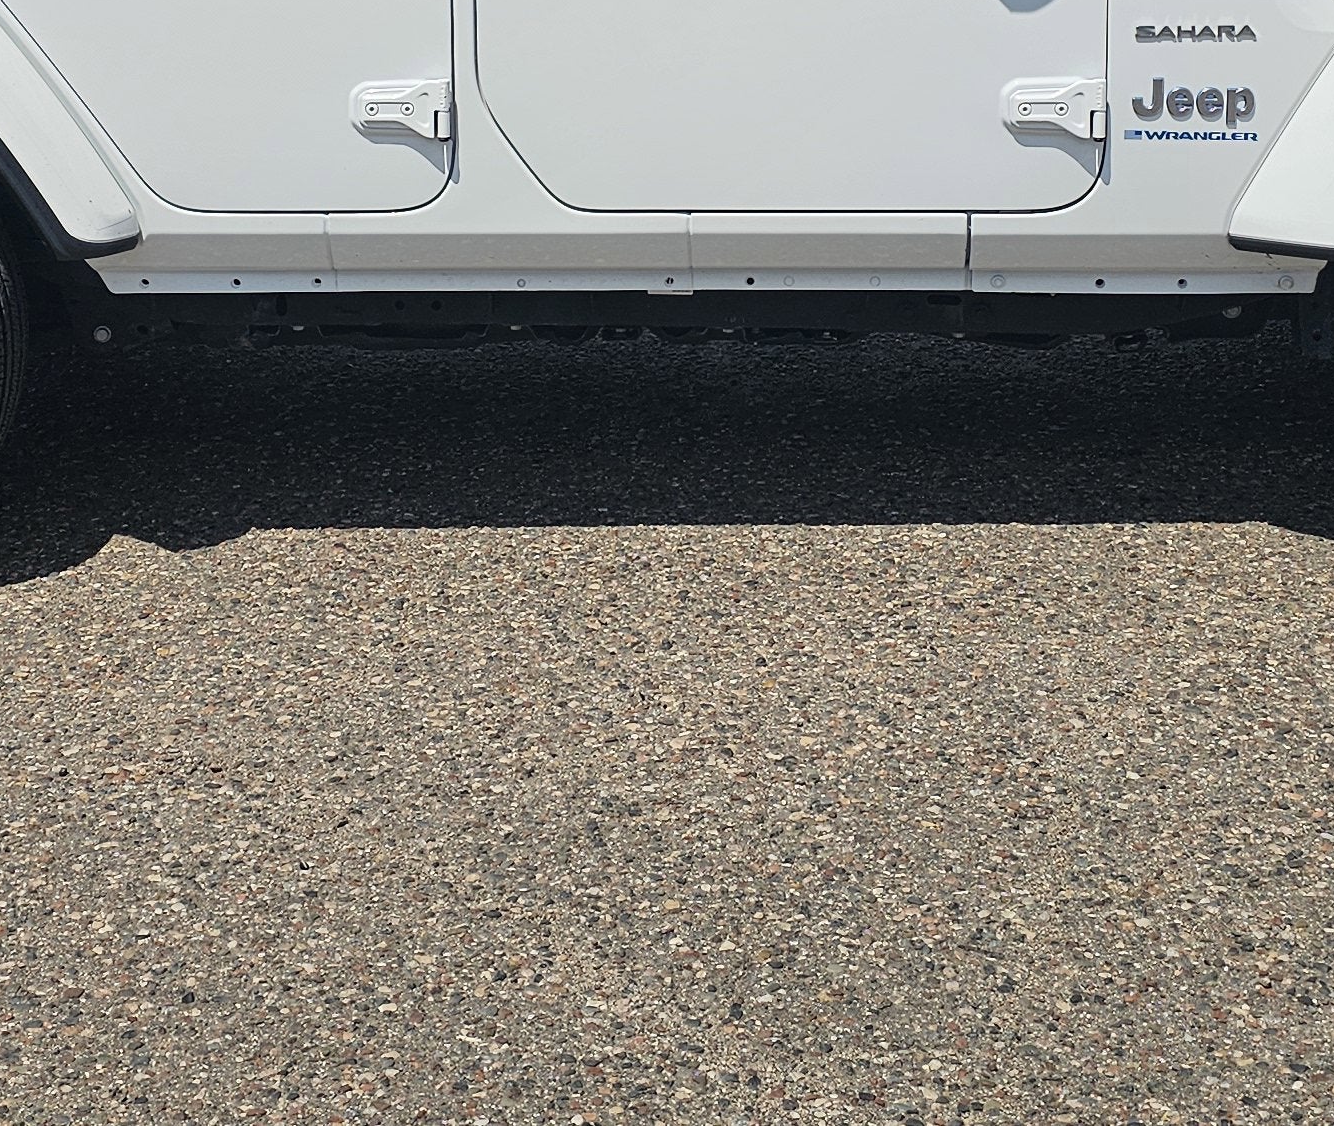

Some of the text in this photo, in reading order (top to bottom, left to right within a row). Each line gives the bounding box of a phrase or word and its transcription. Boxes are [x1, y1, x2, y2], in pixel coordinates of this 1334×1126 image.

[1135, 25, 1258, 43] SAHARA
[1132, 77, 1256, 129] Jeep
[1144, 130, 1258, 141] WRANGLER
